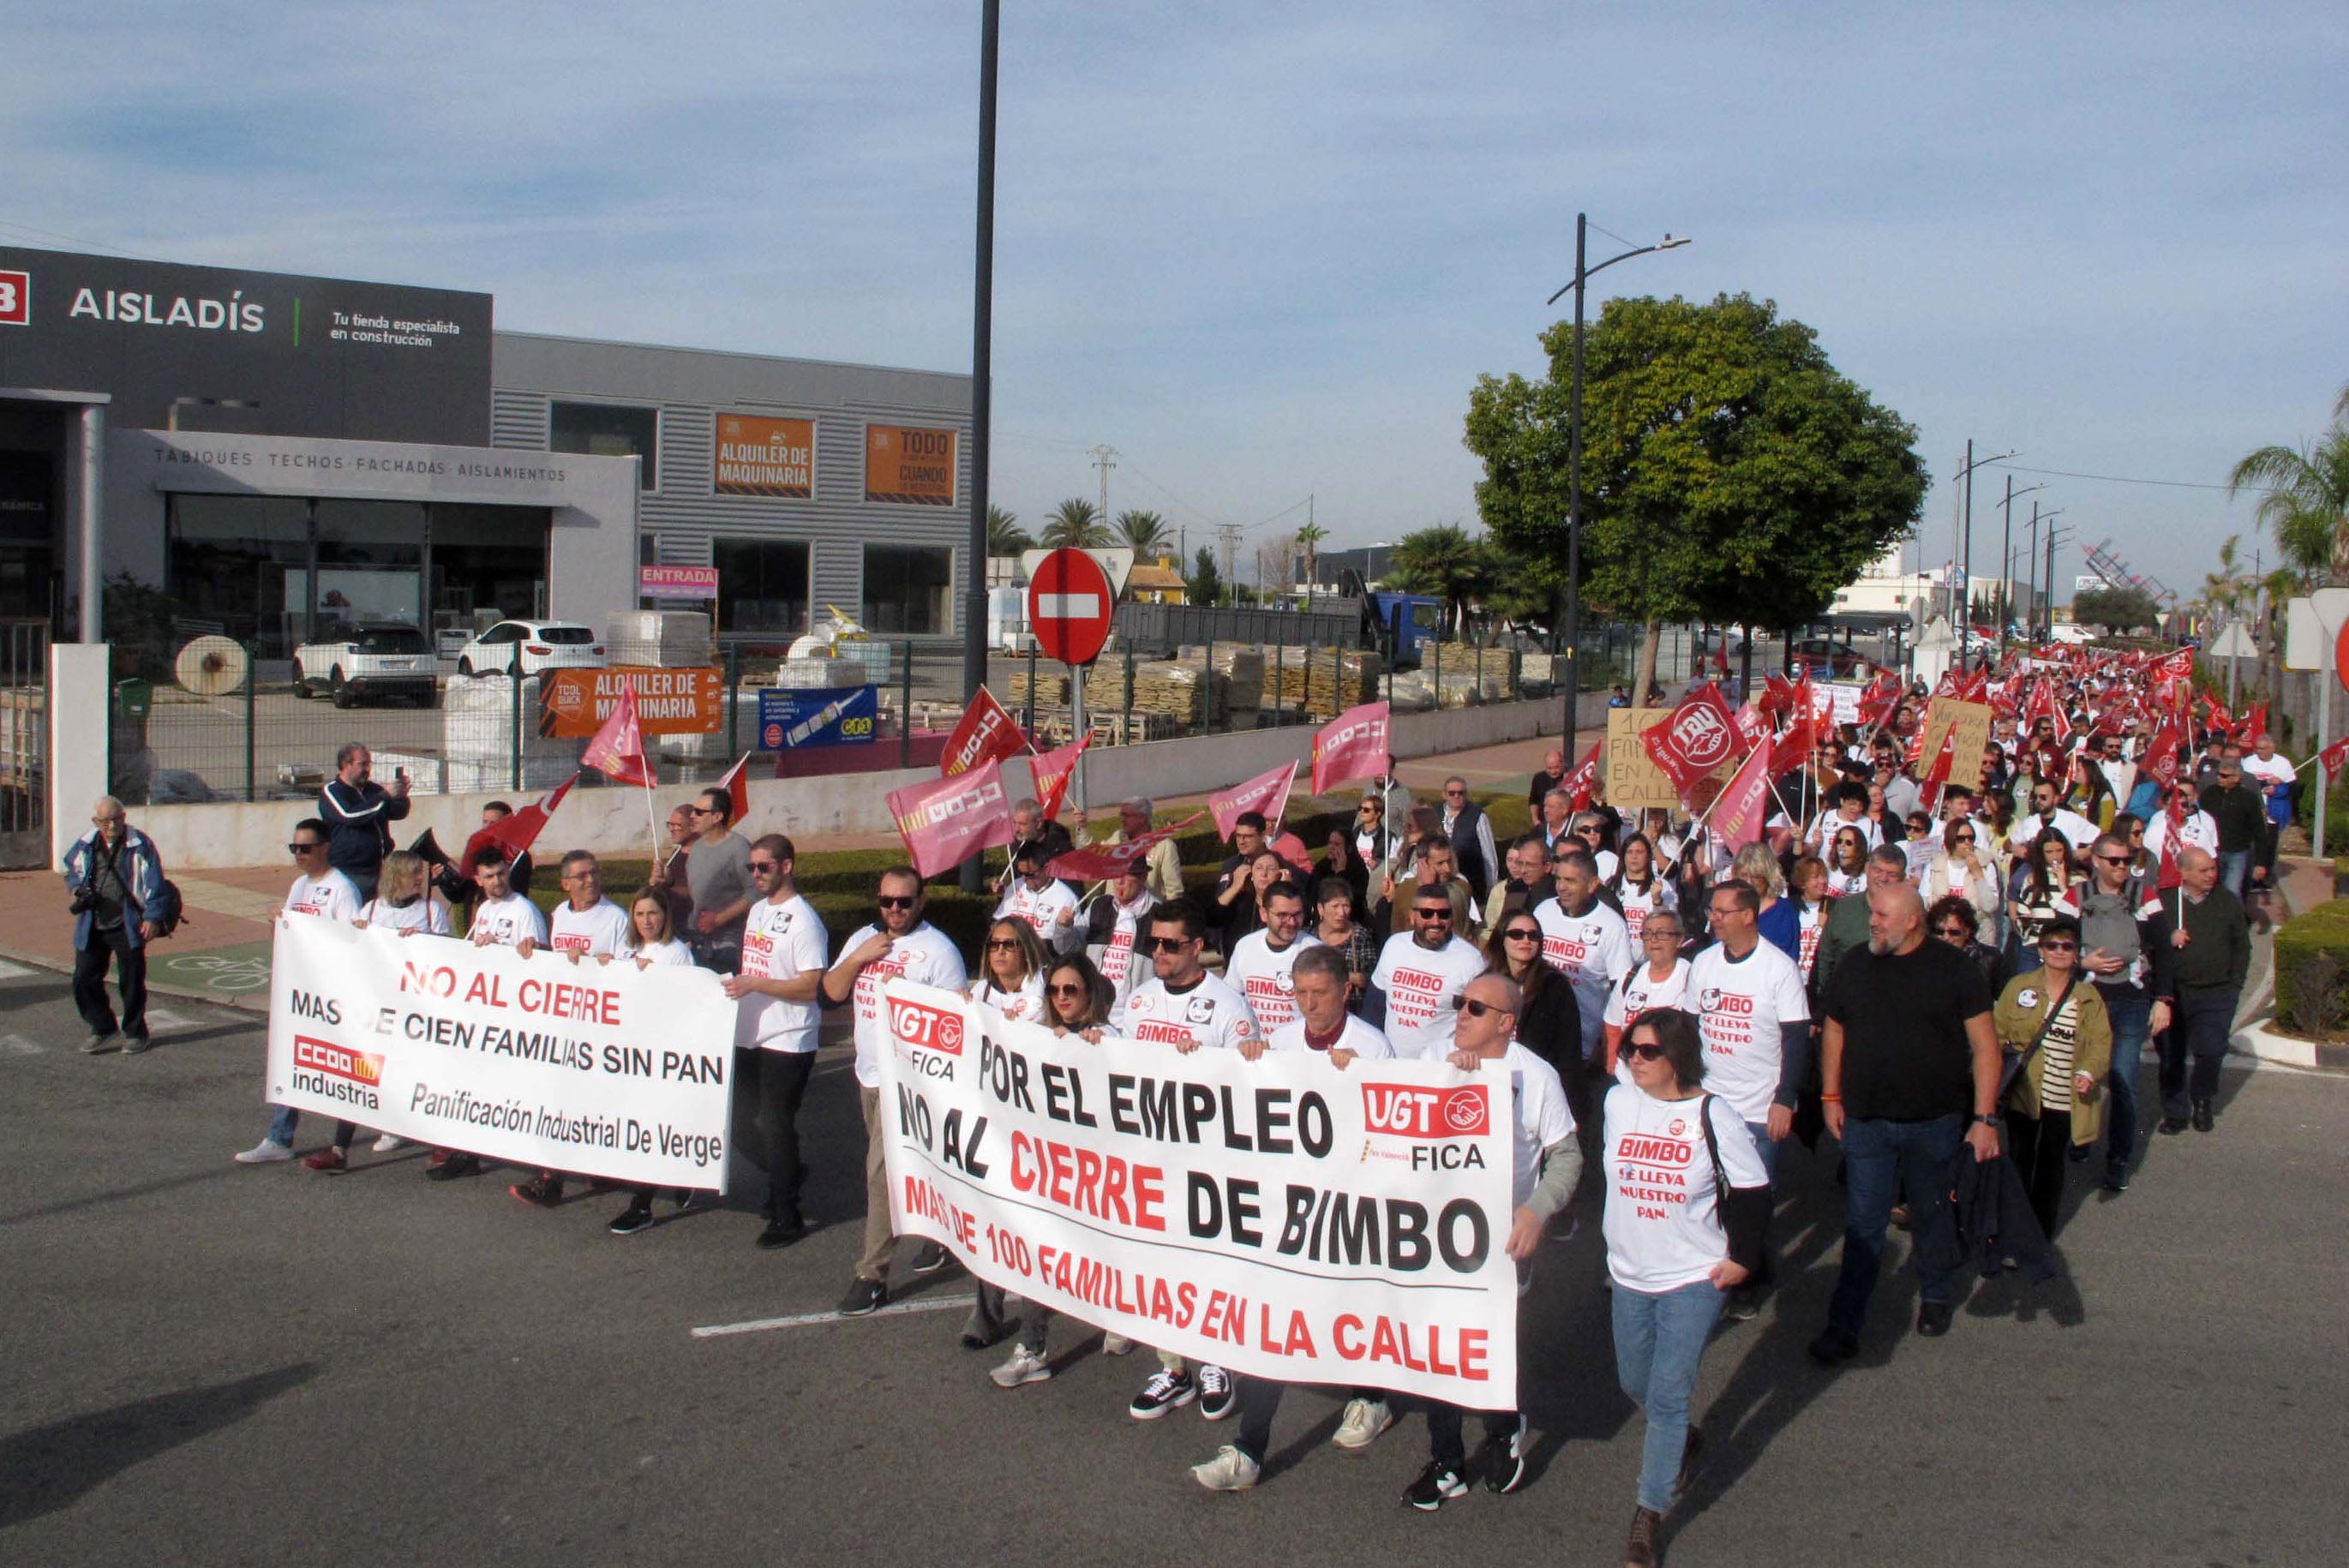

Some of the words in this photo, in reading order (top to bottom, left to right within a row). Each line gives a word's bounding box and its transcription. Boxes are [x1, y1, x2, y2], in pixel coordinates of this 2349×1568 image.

[69, 288, 265, 332] AISLADÍS
[333, 312, 349, 326] Tu
[352, 314, 389, 329] tienda
[393, 320, 460, 335] especialista
[330, 329, 348, 340] en
[351, 331, 432, 347] construcción
[721, 442, 788, 464] ALQUILER
[791, 447, 809, 465] DE
[901, 431, 948, 455] TODO
[153, 449, 253, 465] TABIQUES
[268, 453, 344, 469] TECHOS
[357, 458, 445, 475] FACHADAS
[458, 463, 566, 482] AISLAMIENTOS
[719, 464, 808, 486] MAQUINARIA
[899, 465, 947, 483] CUANDO
[643, 569, 714, 583] ENTRADA
[558, 685, 580, 695] TOOL
[676, 673, 697, 695] DE
[558, 696, 580, 704] QUICK
[1613, 763, 1639, 781] EN
[1543, 939, 1585, 960] BIMBO
[1392, 971, 1443, 991] BIMBO
[400, 961, 457, 999] NO
[464, 972, 507, 1008] AL
[518, 979, 620, 1026] CIERRE
[1392, 990, 1404, 999] SE
[1405, 993, 1438, 1007] LLEVA
[1261, 1002, 1292, 1011] LLEVA
[1389, 1003, 1437, 1018] NUESTRO
[1136, 1024, 1192, 1044] BIMBO
[1715, 1016, 1751, 1030] LLEVA
[291, 989, 342, 1026] MAS
[404, 1013, 476, 1049] CIEN
[481, 1026, 593, 1070] FAMILIAS
[603, 1044, 652, 1077] SIN
[662, 1050, 723, 1085] PAN
[1704, 1027, 1753, 1044] NUESTRO
[297, 1042, 351, 1074] CCOO
[912, 1050, 954, 1081] FICA
[292, 1068, 379, 1110] industria
[980, 1035, 1035, 1113] POR
[1041, 1062, 1098, 1128] EL
[1108, 1073, 1333, 1158] EMPLEO
[1366, 1090, 1438, 1132] UGT
[410, 1082, 533, 1133] Panificación
[536, 1105, 620, 1148] Industrial
[626, 1119, 652, 1153] De
[658, 1123, 722, 1167] Verge
[1412, 1143, 1486, 1171] FICA
[1618, 1138, 1692, 1164] BIMBO
[897, 1081, 933, 1152] NO
[943, 1108, 989, 1180] AL
[1010, 1129, 1166, 1231] CIERRE
[1187, 1170, 1263, 1248] DE
[1276, 1183, 1489, 1273] BIMBO
[1639, 1170, 1686, 1187] LLEVA
[1620, 1185, 1687, 1204] NUESTRO
[1637, 1206, 1669, 1220] PAN.
[950, 1206, 977, 1254] DE
[986, 1223, 1032, 1277] 100
[1038, 1244, 1197, 1329] FAMILIAS
[1200, 1289, 1248, 1345] EN
[1261, 1302, 1317, 1358] LA
[1333, 1314, 1489, 1380] CALLE
